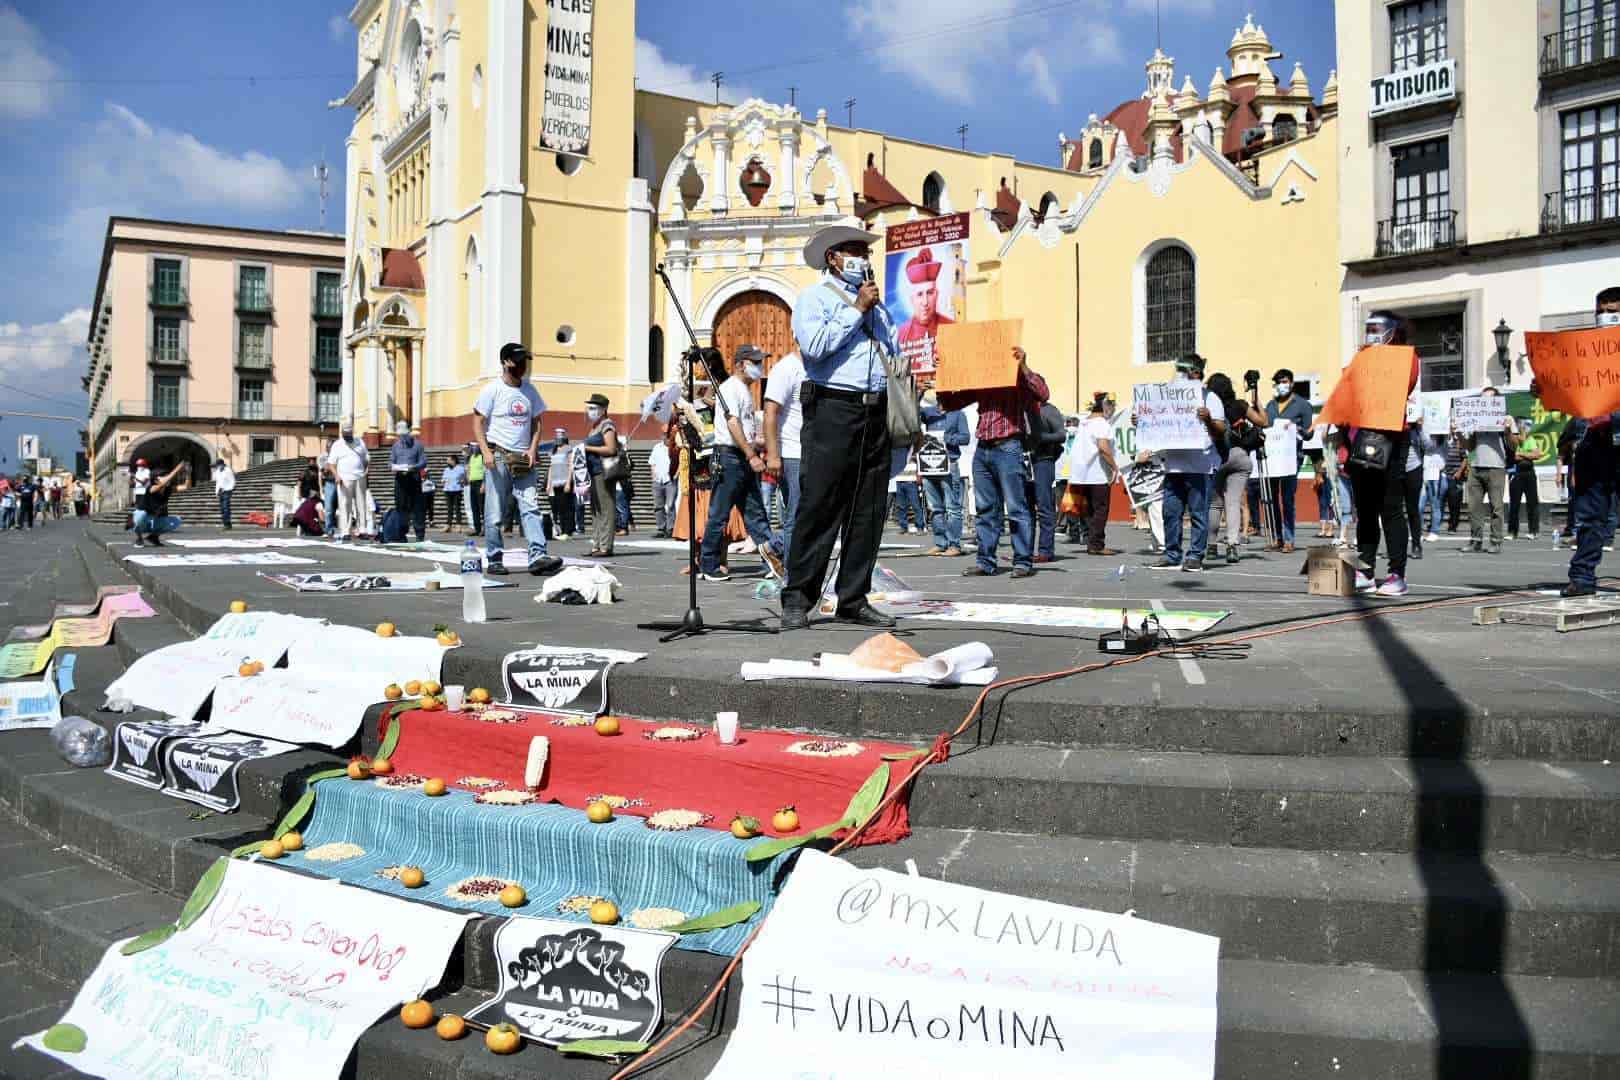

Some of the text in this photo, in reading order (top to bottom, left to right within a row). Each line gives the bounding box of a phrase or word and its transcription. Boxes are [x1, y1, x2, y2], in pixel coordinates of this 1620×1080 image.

[547, 24, 592, 57] MINAS
[1371, 67, 1450, 105] TRIBUNA
[544, 89, 590, 111] PUEBLOS
[541, 117, 590, 141] VERACRUZ
[527, 677, 581, 688] LA MINA
[182, 759, 219, 774] LA MINA
[537, 984, 619, 1011] LA VIDA
[519, 1010, 609, 1033] LA MINA
